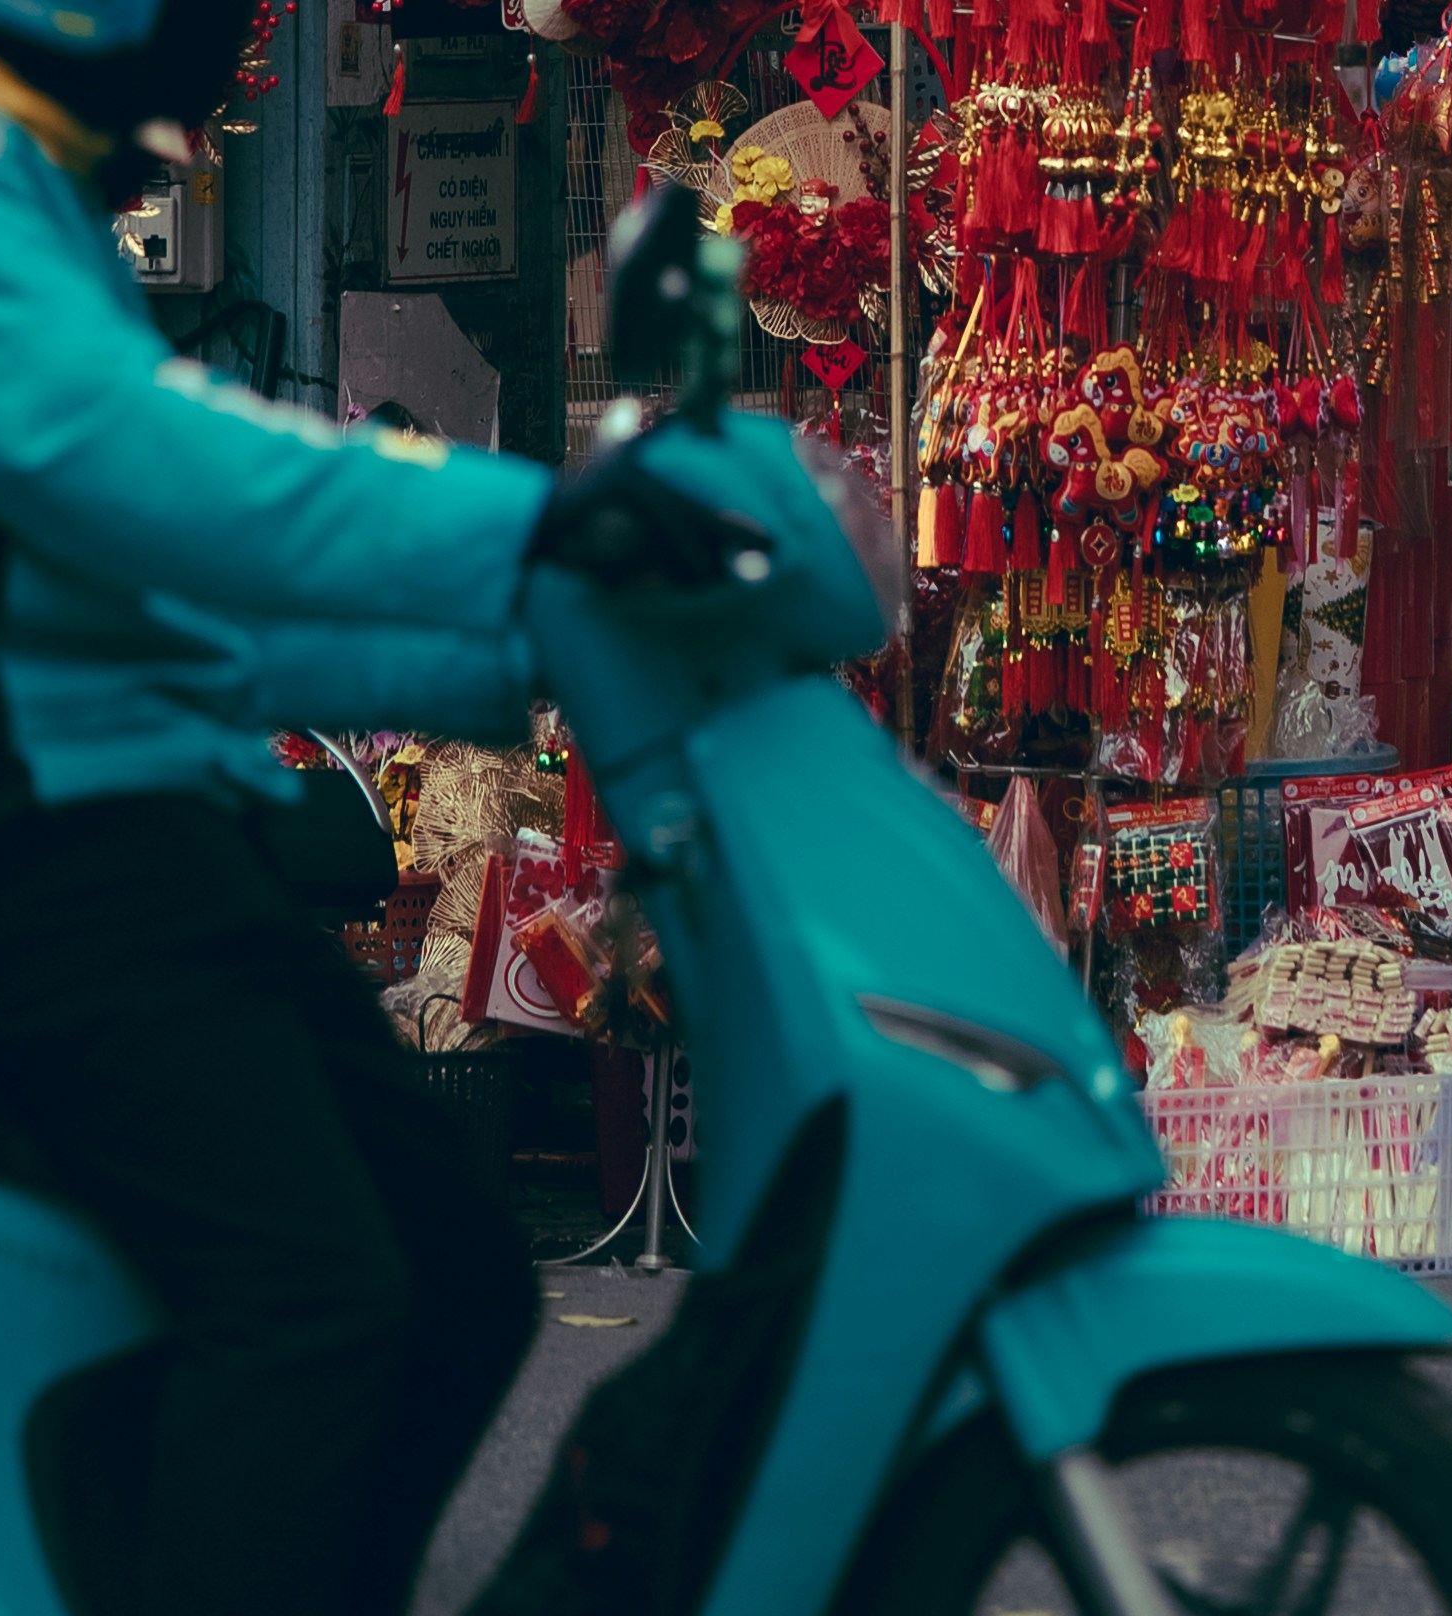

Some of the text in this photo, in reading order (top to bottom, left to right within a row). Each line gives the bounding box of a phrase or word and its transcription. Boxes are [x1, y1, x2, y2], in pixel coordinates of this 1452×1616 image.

[439, 175, 488, 202] CÓ ĐIỆN
[430, 201, 496, 229] NGUY HIỂM
[426, 232, 500, 260] CHẾT NGƯỜI
[1136, 413, 1156, 439] 福
[1103, 465, 1125, 493] 福
